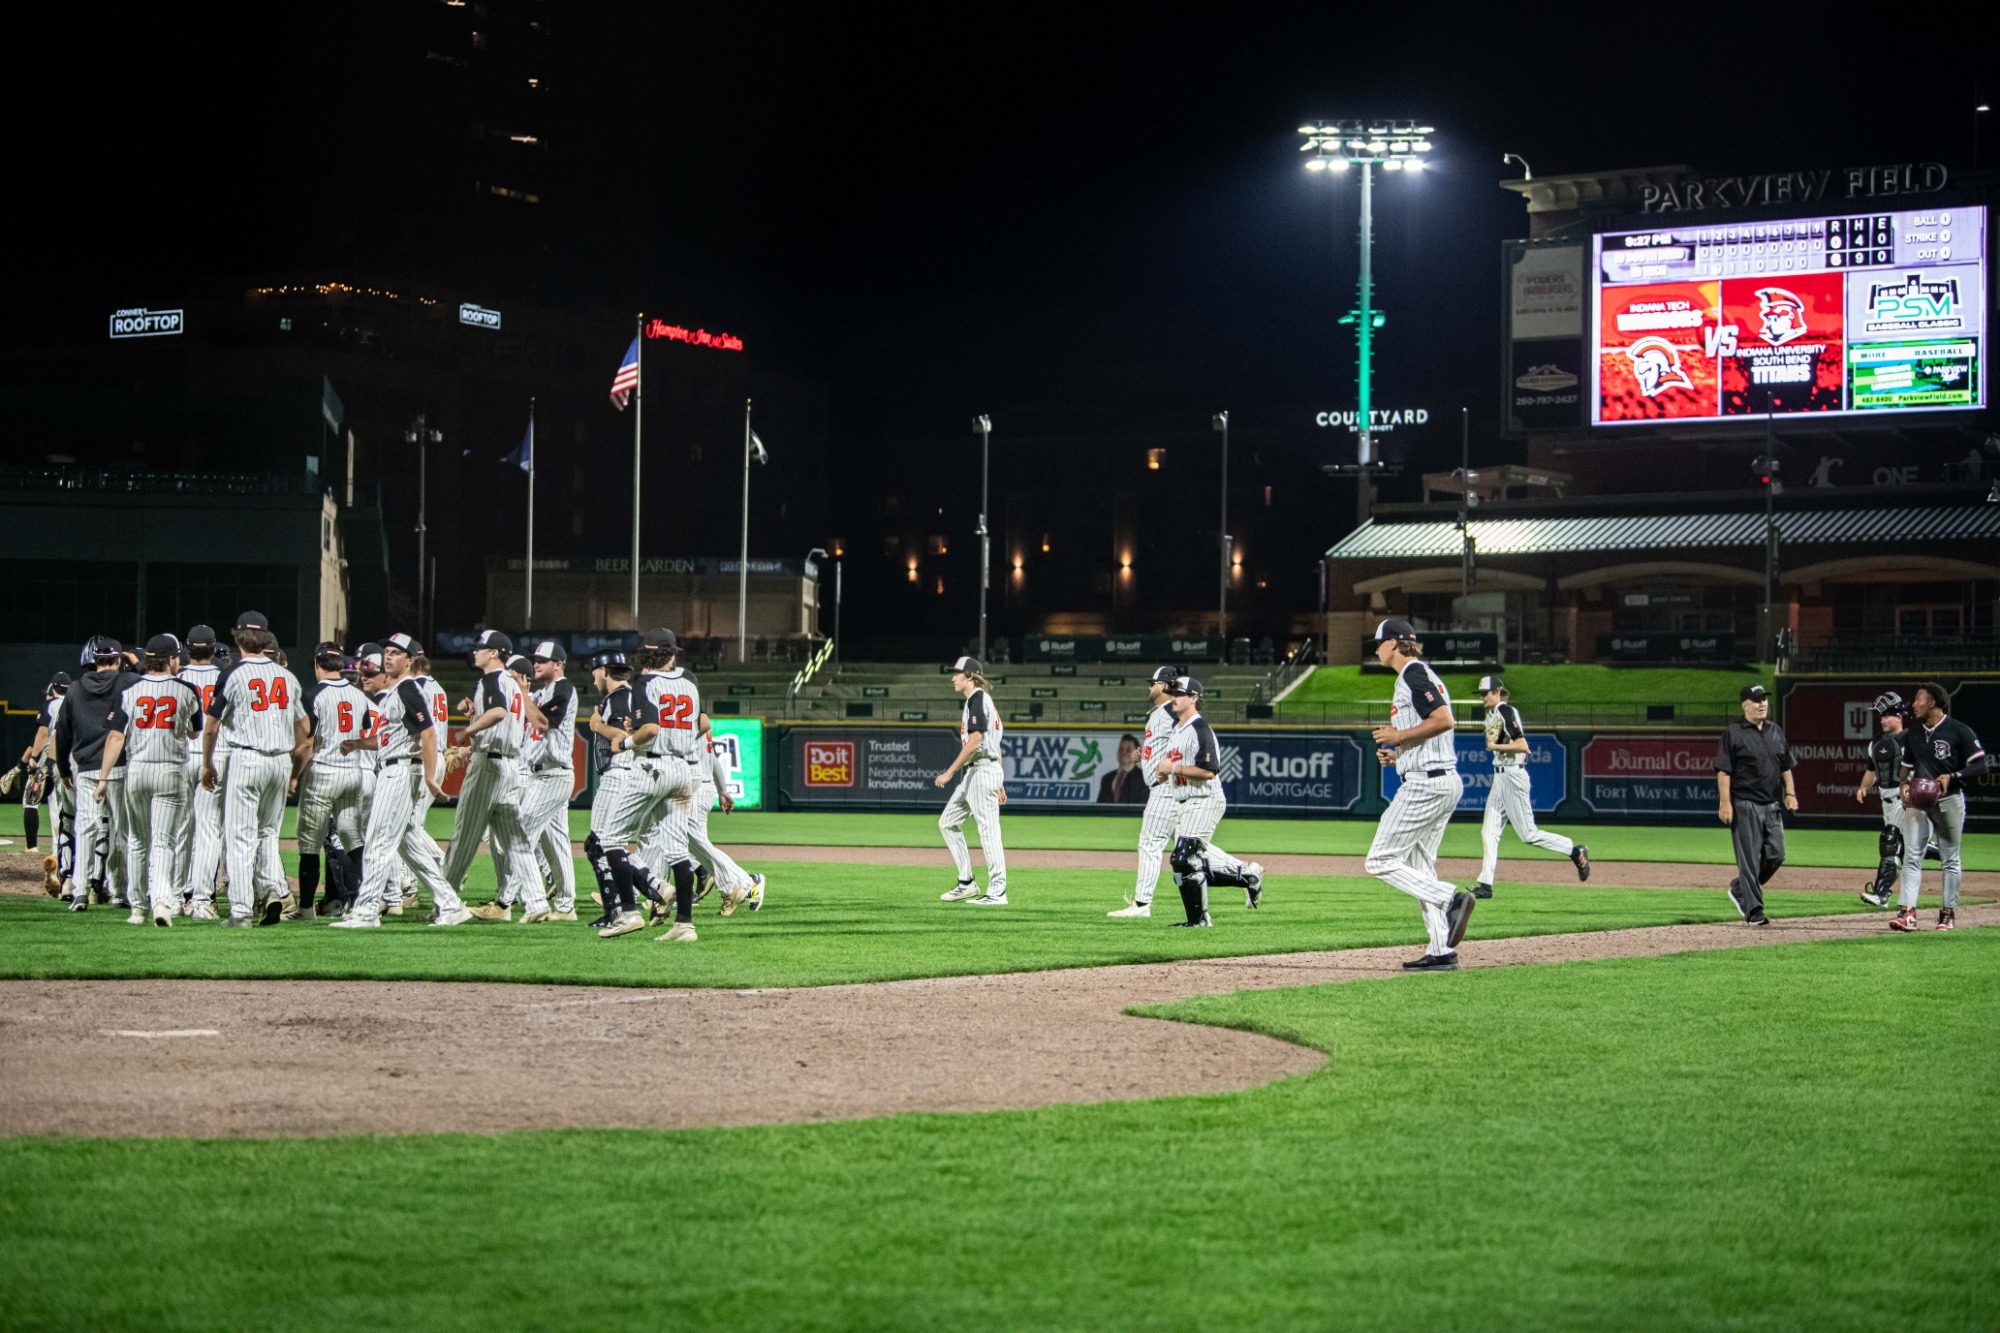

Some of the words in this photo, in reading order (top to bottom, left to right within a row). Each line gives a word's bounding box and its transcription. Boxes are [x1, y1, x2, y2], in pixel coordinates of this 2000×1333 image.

[1640, 169, 1831, 214] PARKVIEW
[1843, 161, 1948, 199] FIELD
[1831, 221, 1840, 232] R
[1854, 220, 1863, 230] H
[1878, 218, 1886, 229] E
[1914, 215, 1937, 226] BALL
[1940, 212, 1951, 226] 0
[1653, 233, 1671, 244] PM
[1830, 235, 1842, 249] 0
[1854, 235, 1863, 246] 4
[1878, 233, 1886, 244] 0
[1905, 232, 1938, 244] STRIKE
[1940, 229, 1951, 243] 0
[1918, 248, 1938, 259] OUT
[1940, 246, 1951, 260] 0
[1757, 261, 1764, 272] 0
[1785, 259, 1793, 270] 0
[1799, 258, 1807, 269] 0
[1854, 252, 1864, 264] 9
[1878, 250, 1886, 262] 0
[1667, 302, 1690, 311] TECH
[1878, 296, 1950, 319] PSM
[114, 314, 179, 333] ROOFTOP
[462, 309, 498, 325] ROOFTOP
[1867, 321, 1917, 331] BASEBALL
[646, 319, 692, 343] Hampton
[692, 329, 713, 346] Inn
[720, 333, 743, 351] Suites
[1704, 325, 1739, 357] VS
[1736, 347, 1773, 358] INDIANA
[1774, 344, 1826, 356] UNIVERSITY
[1914, 348, 1963, 357] BASEBALL
[1753, 356, 1784, 366] SOUTH
[1786, 354, 1811, 365] BEND
[1751, 364, 1811, 383] TITANS
[1872, 465, 1919, 486] ONE
[595, 558, 629, 573] BEER
[1051, 641, 1075, 651] Ruoff
[1116, 641, 1142, 651] Ruoff
[1183, 641, 1208, 651] Ruoff
[1456, 639, 1481, 650] Ruoff
[1622, 639, 1648, 650] Ruoff
[1691, 638, 1718, 649] Ruoff
[248, 677, 289, 711] 34
[135, 695, 177, 729] 32
[433, 693, 447, 722] 45
[659, 694, 693, 730] 22
[338, 701, 353, 732] 6
[868, 740, 910, 752] Trusted
[1001, 736, 1070, 758] SHAW
[1790, 745, 1844, 760] INDIANA
[811, 747, 834, 765] Do
[835, 746, 848, 764] it
[1608, 750, 1671, 770] Journal
[1013, 758, 1068, 778] LAW
[1249, 751, 1335, 779] Ruoff
[1835, 762, 1854, 772] FORT
[810, 764, 849, 783] Best
[1026, 783, 1086, 798] 777-7777
[1249, 783, 1333, 798] MORTGAGE
[1595, 783, 1628, 798] FORT
[1633, 785, 1680, 799] WAYNE
